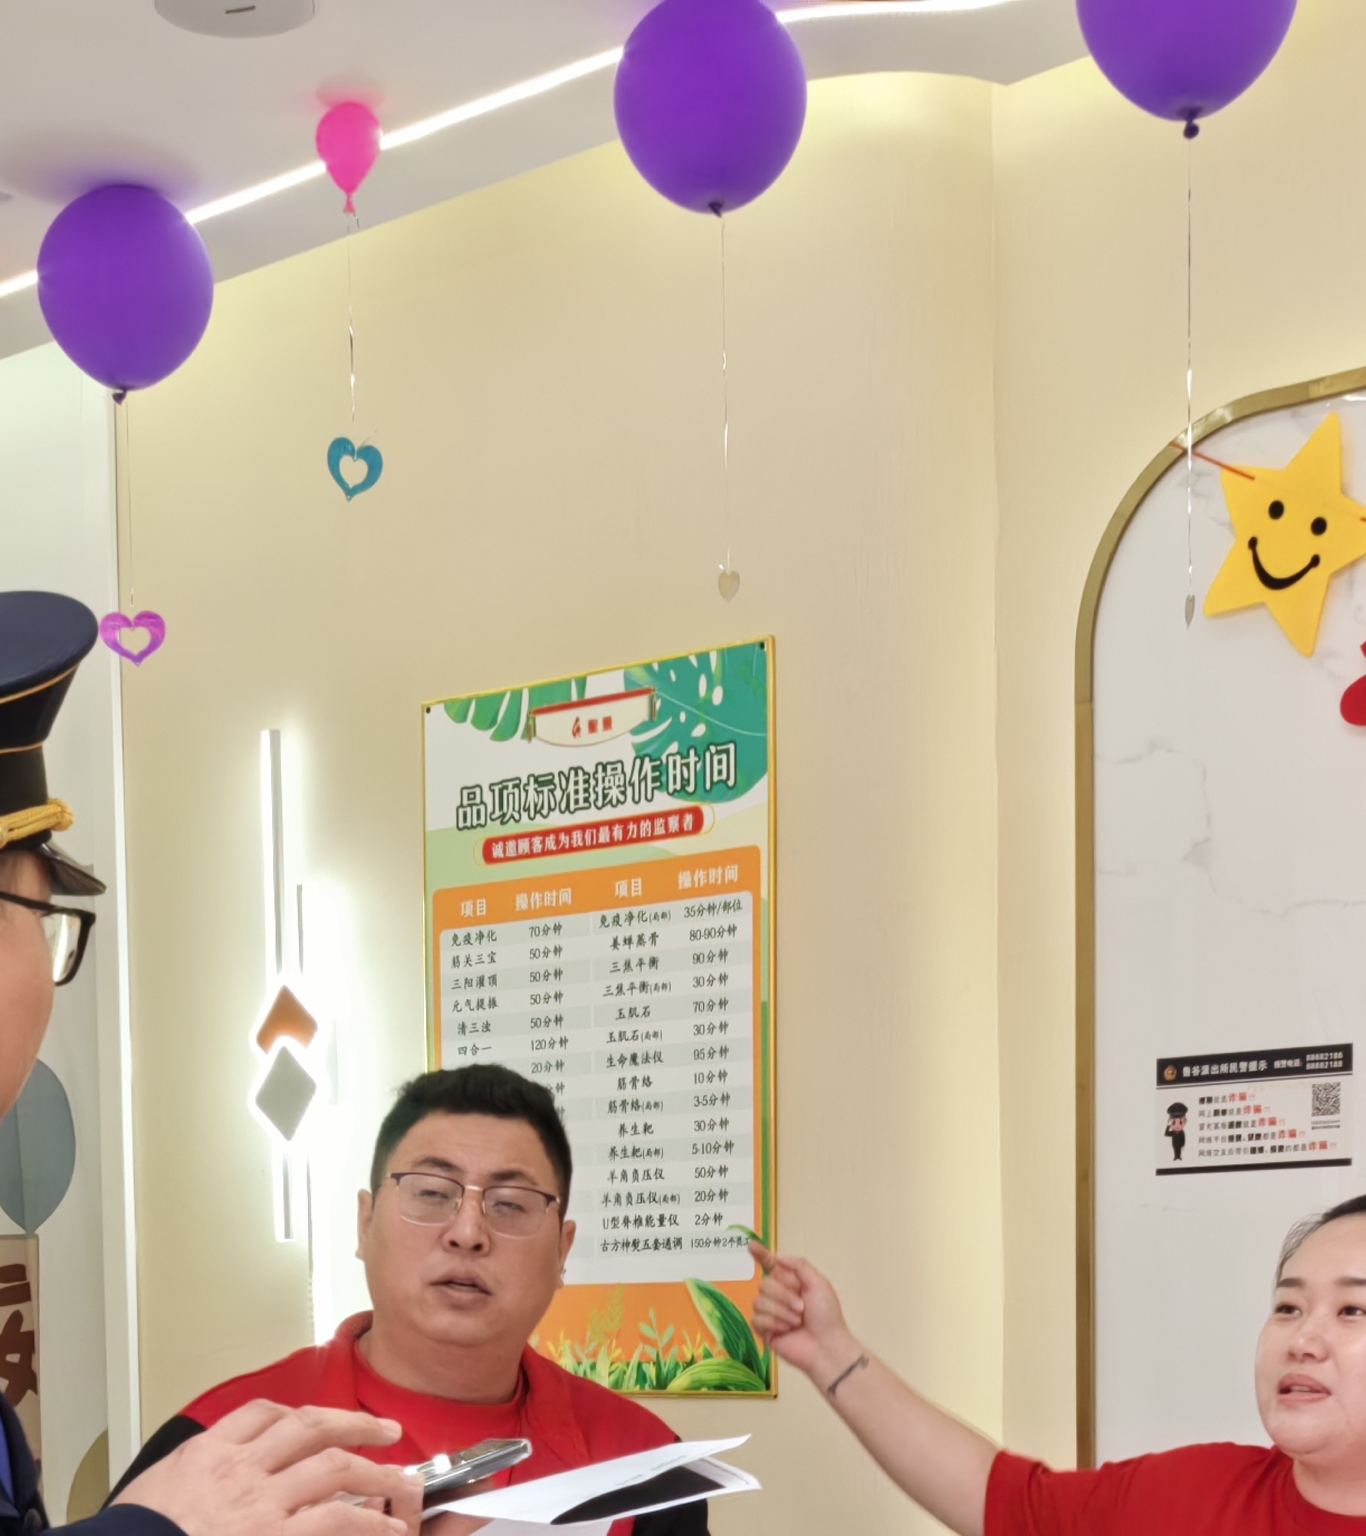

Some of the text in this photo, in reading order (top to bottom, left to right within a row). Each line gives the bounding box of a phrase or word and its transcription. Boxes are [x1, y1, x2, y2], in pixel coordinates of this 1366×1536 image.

[457, 742, 736, 830] 品项标准操作时间
[461, 865, 738, 917] 项目 操作时间 项目 操作时间
[529, 922, 563, 938] 70分钟
[529, 945, 563, 960] 50分钟
[692, 948, 729, 964] 90分钟
[530, 968, 563, 983] 50分钟
[692, 972, 729, 988] 30分钟
[530, 990, 564, 1005] 50分钟
[692, 997, 729, 1013] 70分钟
[530, 1014, 564, 1029] 50分钟
[693, 1020, 729, 1036] 30分钟
[458, 1036, 569, 1056] 四合一 120分钟
[531, 1059, 565, 1073] 20分钟
[693, 1069, 728, 1085] 10分钟
[693, 1117, 729, 1132] 30分钟
[694, 1164, 729, 1179] 50分钟
[694, 1188, 729, 1203] 20分钟
[694, 1212, 723, 1227] 2分钟
